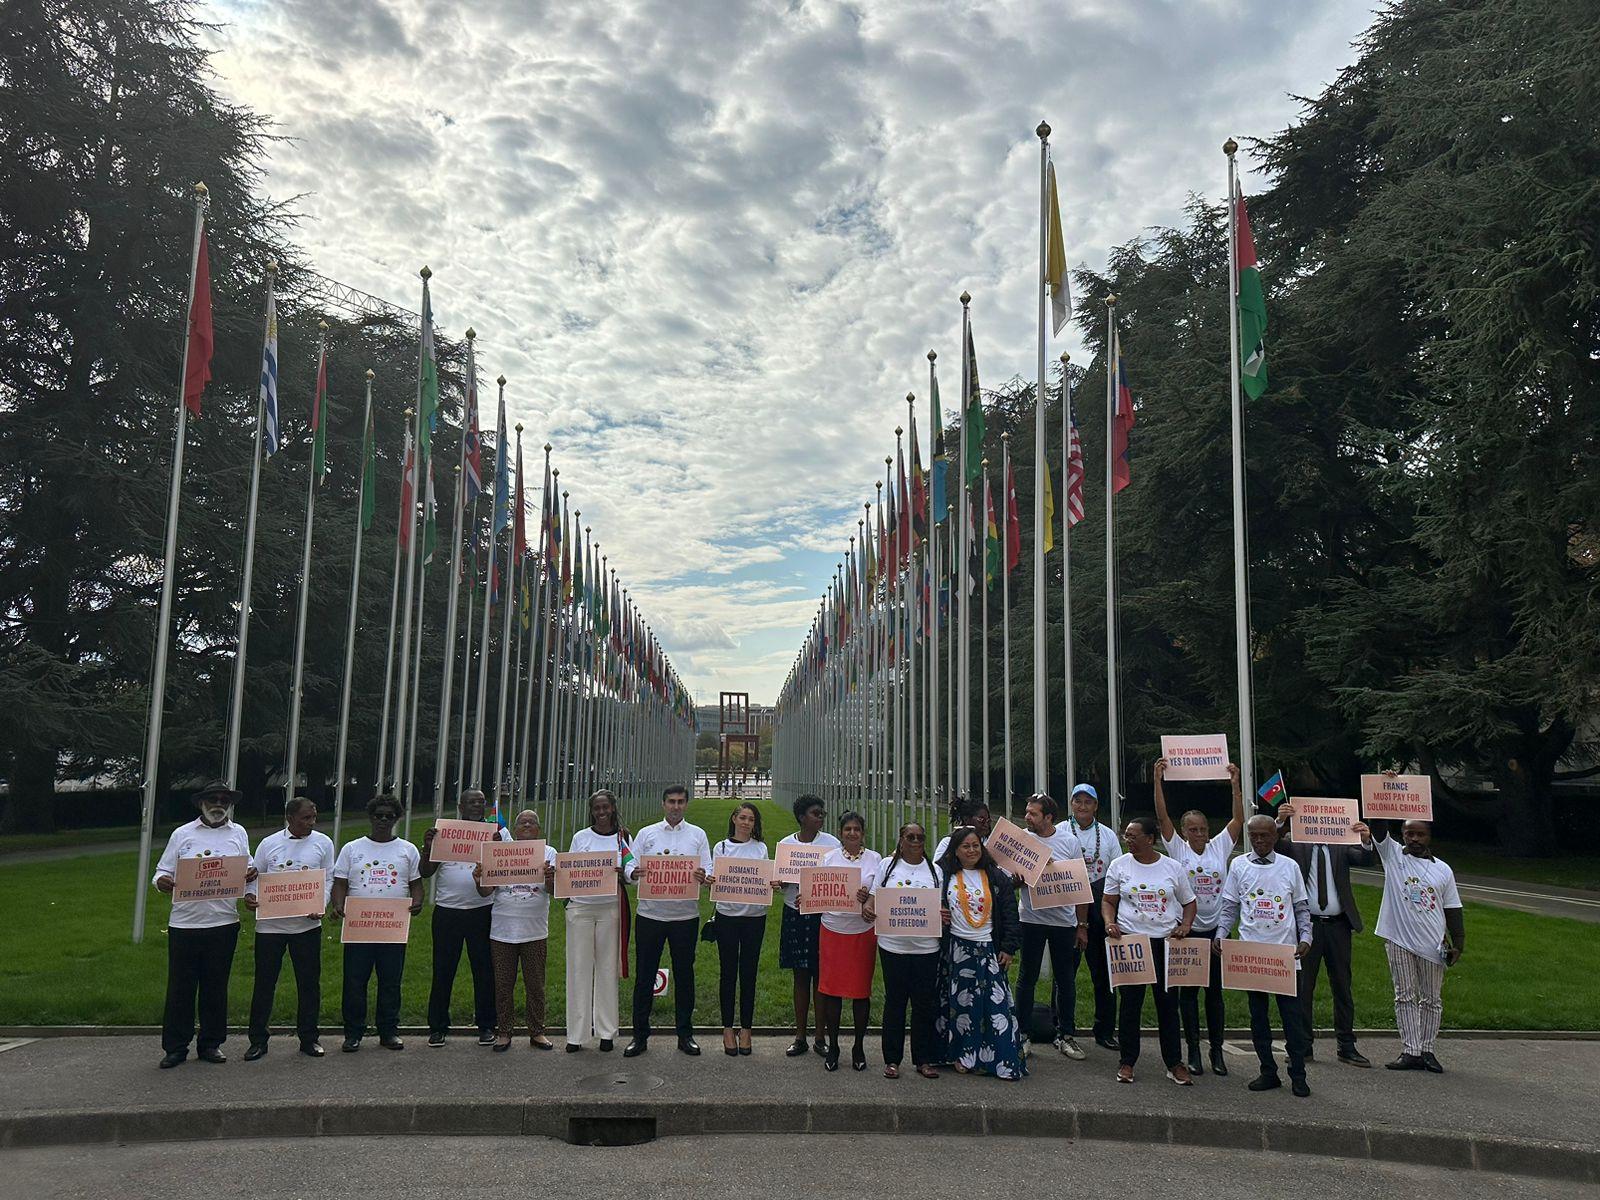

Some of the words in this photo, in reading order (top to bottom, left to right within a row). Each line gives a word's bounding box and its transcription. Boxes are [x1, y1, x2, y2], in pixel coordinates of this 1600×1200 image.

[1168, 748, 1176, 756] NO
[1185, 747, 1221, 755] ASSIMILATION
[1169, 757, 1182, 766] YES
[1182, 757, 1190, 766] TO
[1192, 756, 1223, 766] IDENTITY!
[1383, 782, 1408, 791] FRANCE
[1374, 792, 1392, 800] MUST
[1392, 793, 1406, 801] PAY
[1406, 794, 1420, 802] FOR
[1303, 805, 1319, 814] STOP
[1320, 806, 1346, 814] FRANCE
[1367, 803, 1398, 811] COLONIAL
[1399, 804, 1427, 813] CRIMES!
[1300, 816, 1318, 824] FROM
[1320, 816, 1350, 826] STEALING
[441, 828, 489, 842] DECOLONIZE
[1305, 826, 1318, 835] OUR
[1320, 827, 1346, 836] FUTURE!
[452, 843, 475, 855] NOW!
[999, 832, 1009, 842] NO
[1008, 837, 1025, 852] PEACE
[1023, 846, 1040, 863] UNTIL
[492, 848, 534, 857] COLONIALISM
[790, 851, 820, 859] DECOLONIZE
[994, 841, 1013, 861] FRANCE
[1013, 853, 1036, 871] LEAVES!
[202, 861, 220, 870] STOP
[497, 860, 504, 868] IS
[510, 859, 529, 867] CRIME
[573, 860, 601, 868] CULTURES
[647, 861, 660, 870] END
[661, 861, 694, 870] FRANCE'S
[195, 871, 228, 879] EXPLOITING
[487, 870, 509, 878] AGAINST
[510, 868, 538, 876] HUMANITY!
[569, 870, 580, 878] NOT
[581, 869, 604, 878] FRENCH
[728, 866, 759, 875] DISMANTLE
[646, 871, 692, 884] COLONIAL
[719, 875, 740, 884] FRENCH
[740, 876, 766, 886] CONTROL,
[812, 873, 848, 882] DECOLONIZE
[1041, 870, 1074, 882] COLONIAL
[200, 880, 221, 888] AFRICA
[264, 885, 287, 893] JUSTICE
[288, 882, 312, 892] DELAYED
[313, 882, 320, 890] IS
[571, 880, 601, 888] PROPERTY!
[180, 890, 191, 898] FOR
[192, 889, 215, 897] FRENCH
[650, 886, 667, 895] GRIP
[668, 886, 686, 894] NOW!
[715, 885, 743, 894] EMPOWER
[743, 887, 769, 896] NATIONS!
[811, 883, 850, 899] AFRICA,
[1036, 884, 1054, 896] RULE
[1054, 884, 1061, 893] IS
[1062, 882, 1083, 892] THEFT!
[268, 894, 291, 903] JUSTICE
[292, 892, 315, 900] DENIED!
[900, 896, 917, 904] FROM
[806, 900, 836, 908] DECOLONIZE
[836, 899, 854, 907] MINDS!
[890, 908, 926, 917] RESISTANCE
[374, 921, 404, 929] PRESENCE!
[889, 919, 897, 927] TO
[897, 919, 928, 928] FREEDOM!
[1127, 943, 1143, 960] TO
[1181, 947, 1187, 955] IS
[1192, 958, 1202, 966] ALL
[1231, 955, 1243, 963] END
[1244, 956, 1287, 968] EXPLOITATION,
[1228, 964, 1248, 973] HONOR
[1249, 966, 1290, 978] SOVEREIGNTY!
